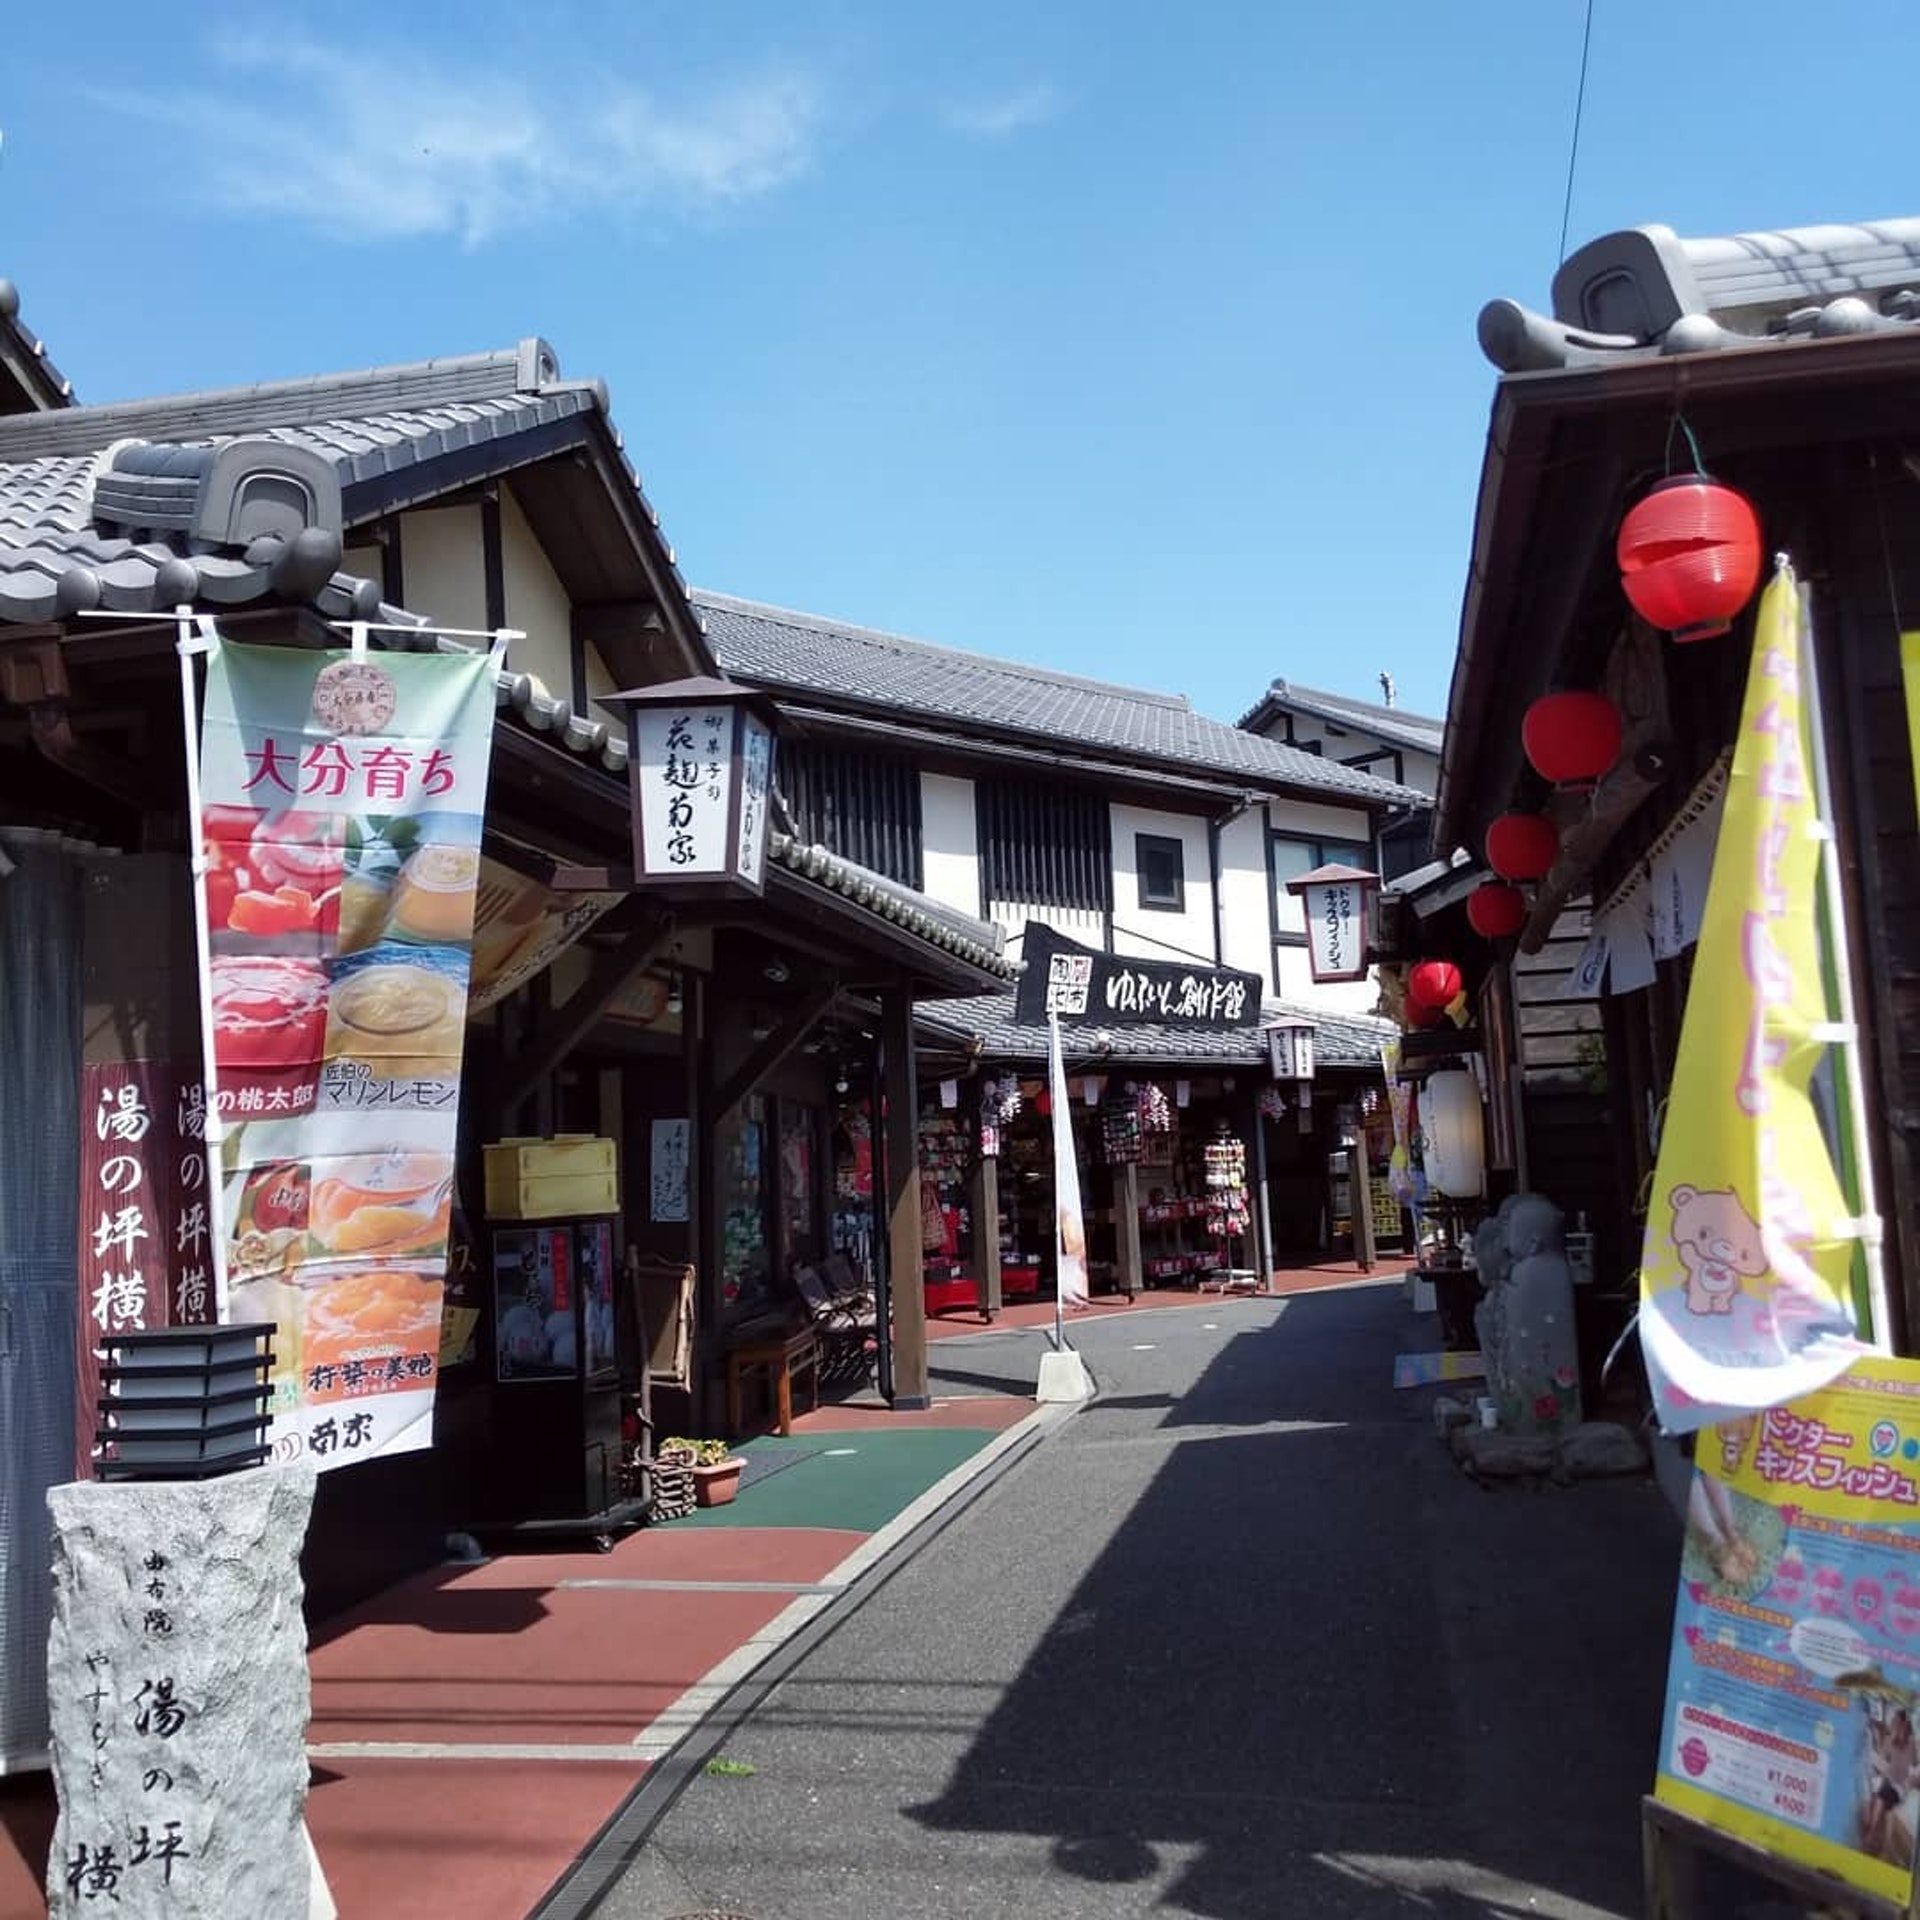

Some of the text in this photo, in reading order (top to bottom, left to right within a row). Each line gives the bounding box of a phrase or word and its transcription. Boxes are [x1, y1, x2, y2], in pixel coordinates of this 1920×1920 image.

[241, 738, 456, 798] 大分育ち
[324, 1080, 456, 1106] マリンレモン
[325, 1063, 373, 1080] 佐伯の
[217, 1084, 314, 1111] の桃太郎
[308, 1412, 374, 1456] 菊家
[1754, 1445, 1919, 1504] キッスフィッシュ
[143, 1549, 173, 1633] 由布院
[129, 1677, 190, 1888] 湯の坪
